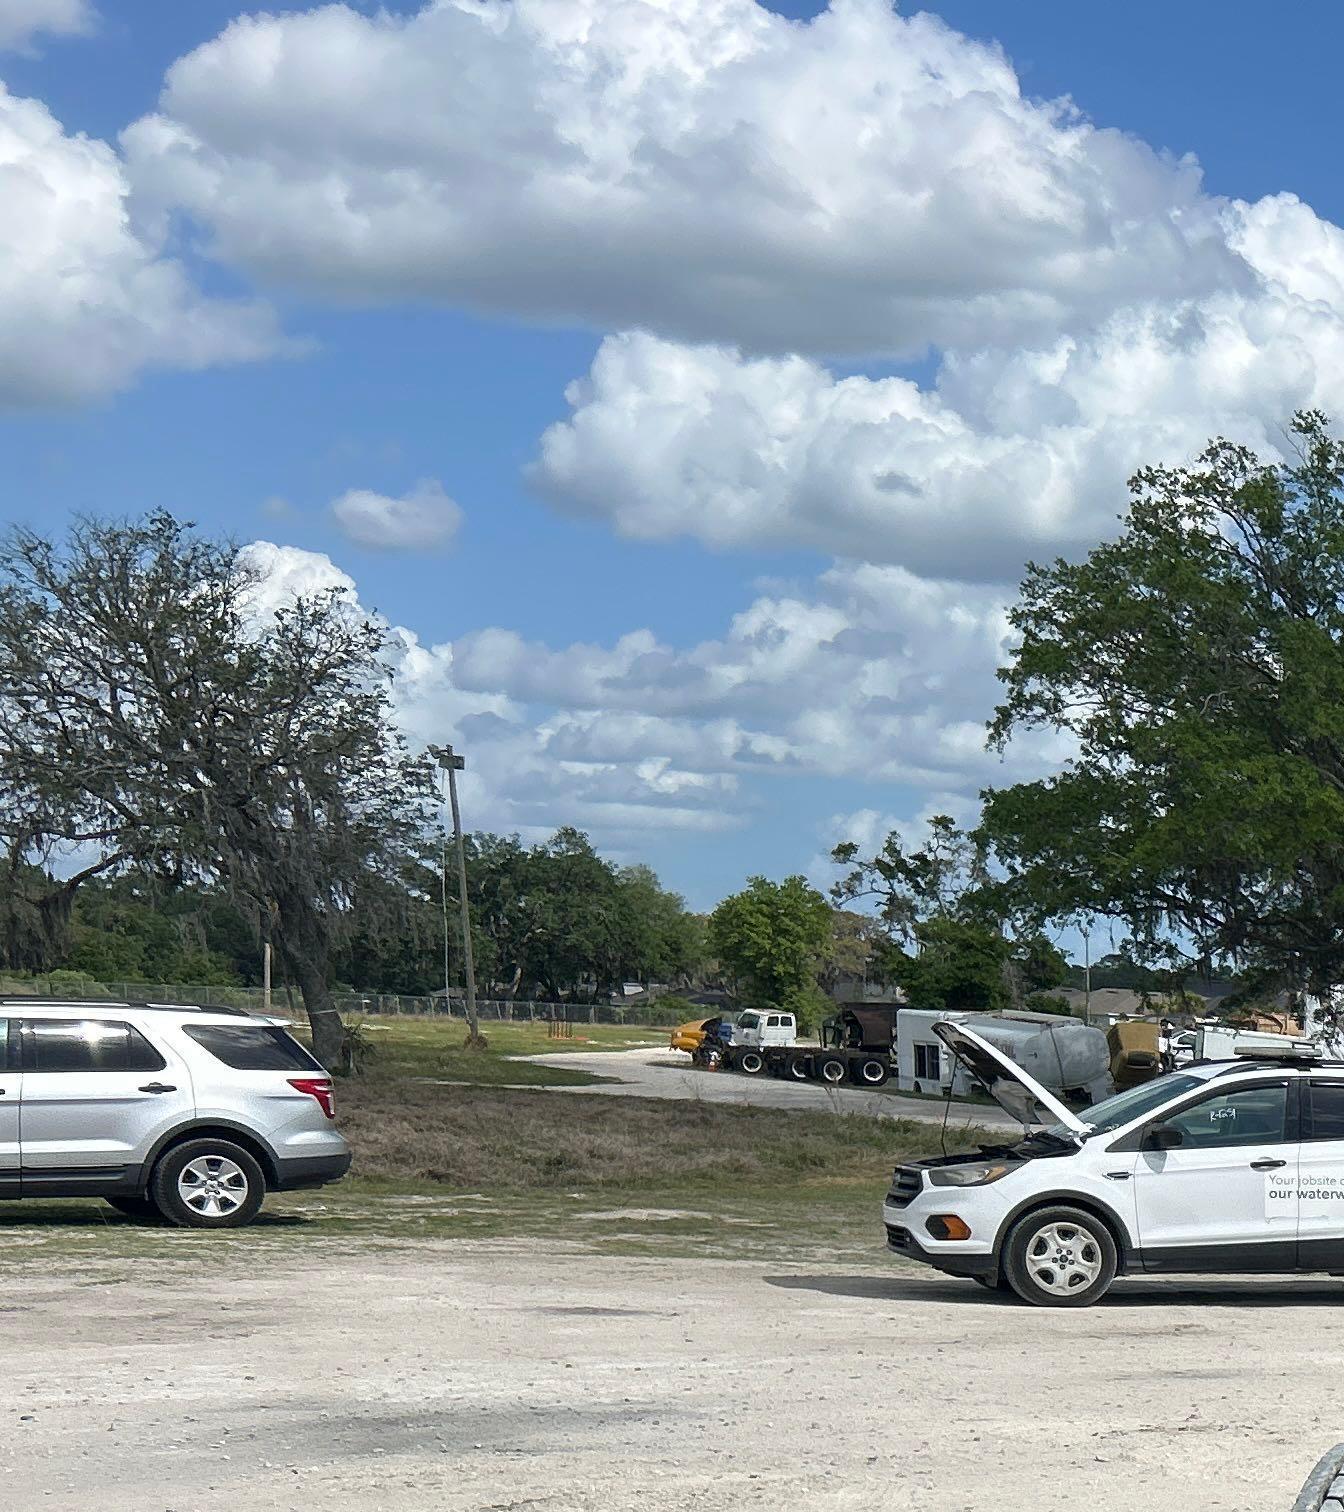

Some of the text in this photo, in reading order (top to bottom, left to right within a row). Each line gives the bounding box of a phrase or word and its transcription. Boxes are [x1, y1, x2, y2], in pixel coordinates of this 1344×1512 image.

[1269, 1175, 1297, 1186] Your
[1298, 1175, 1337, 1187] jobsite
[1269, 1189, 1294, 1199] our
